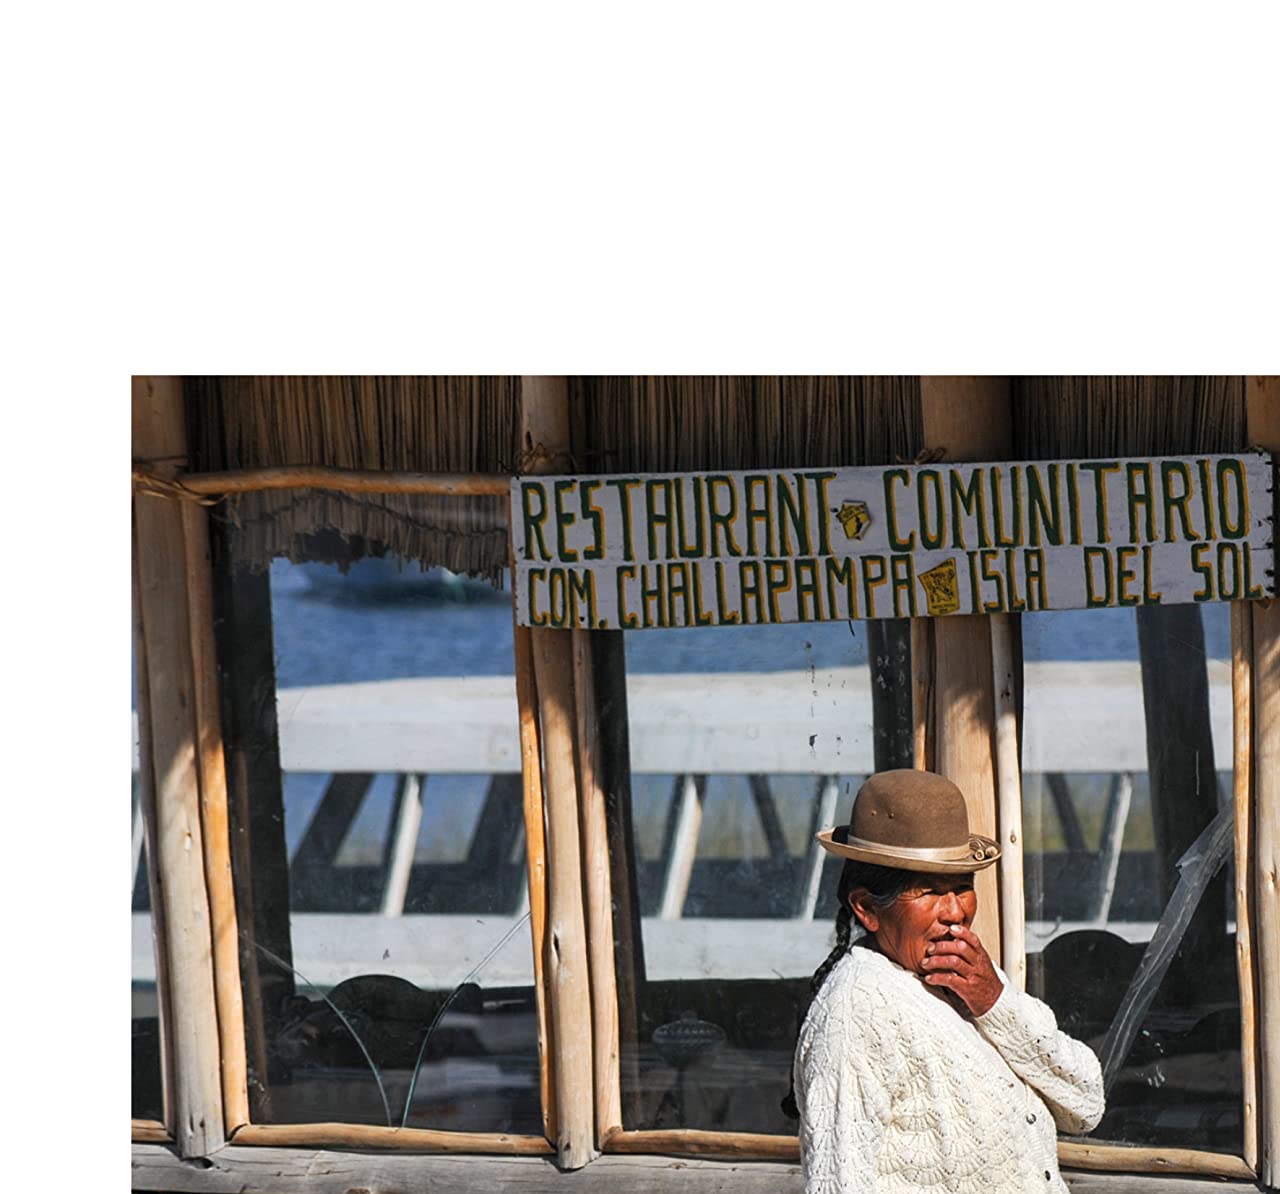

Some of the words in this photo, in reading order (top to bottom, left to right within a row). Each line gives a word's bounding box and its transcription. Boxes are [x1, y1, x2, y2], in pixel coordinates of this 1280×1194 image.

[521, 472, 837, 562] RESTAURANT
[883, 457, 1251, 552] COMUNITARIO
[528, 567, 608, 629] COM.
[616, 554, 918, 629] CHALLAPAMPA
[967, 546, 1049, 613] ISLA
[1084, 545, 1162, 609] DEL
[1191, 541, 1264, 602] SOL
